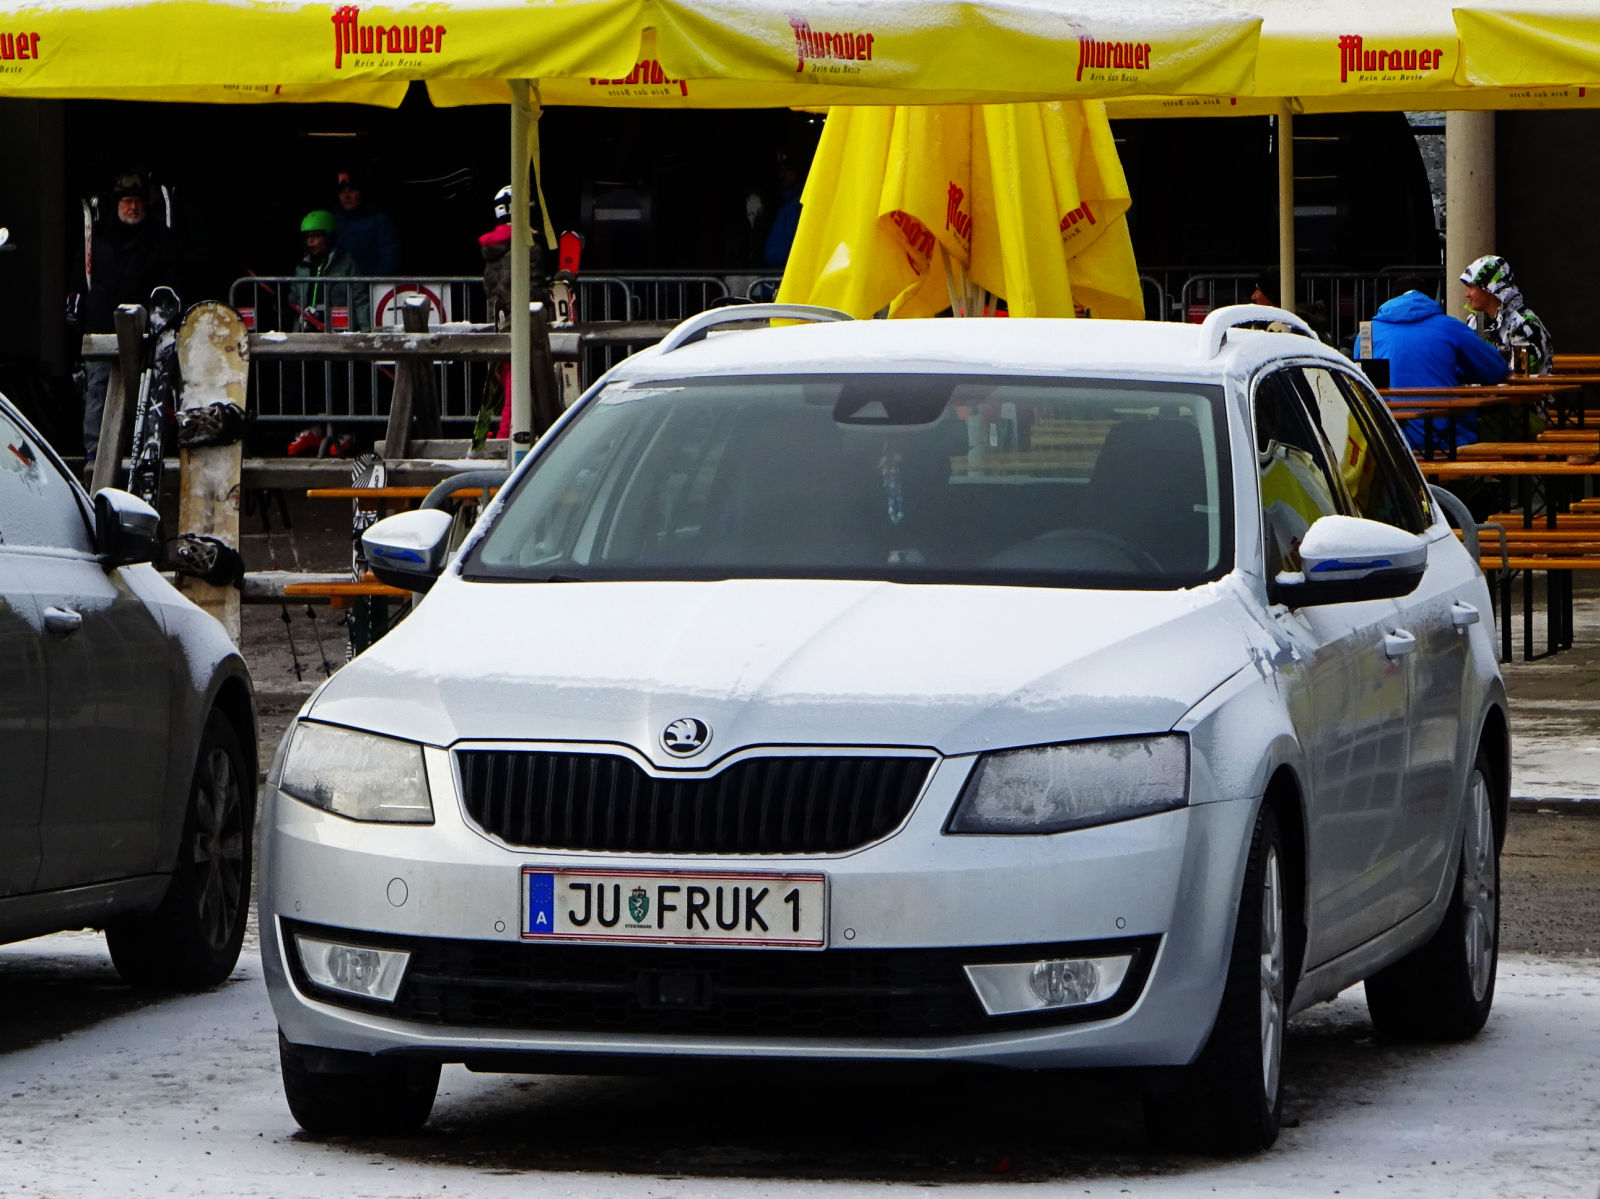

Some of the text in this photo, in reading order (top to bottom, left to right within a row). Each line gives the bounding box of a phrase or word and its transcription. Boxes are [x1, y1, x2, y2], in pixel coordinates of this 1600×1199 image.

[0, 32, 40, 60] uer
[331, 5, 446, 69] Murauer
[789, 16, 874, 73] Murauer
[1338, 34, 1443, 83] Murauer
[354, 58, 423, 68] Rein das Beste
[536, 911, 548, 925] A
[569, 883, 800, 933] JU FRUK 1
